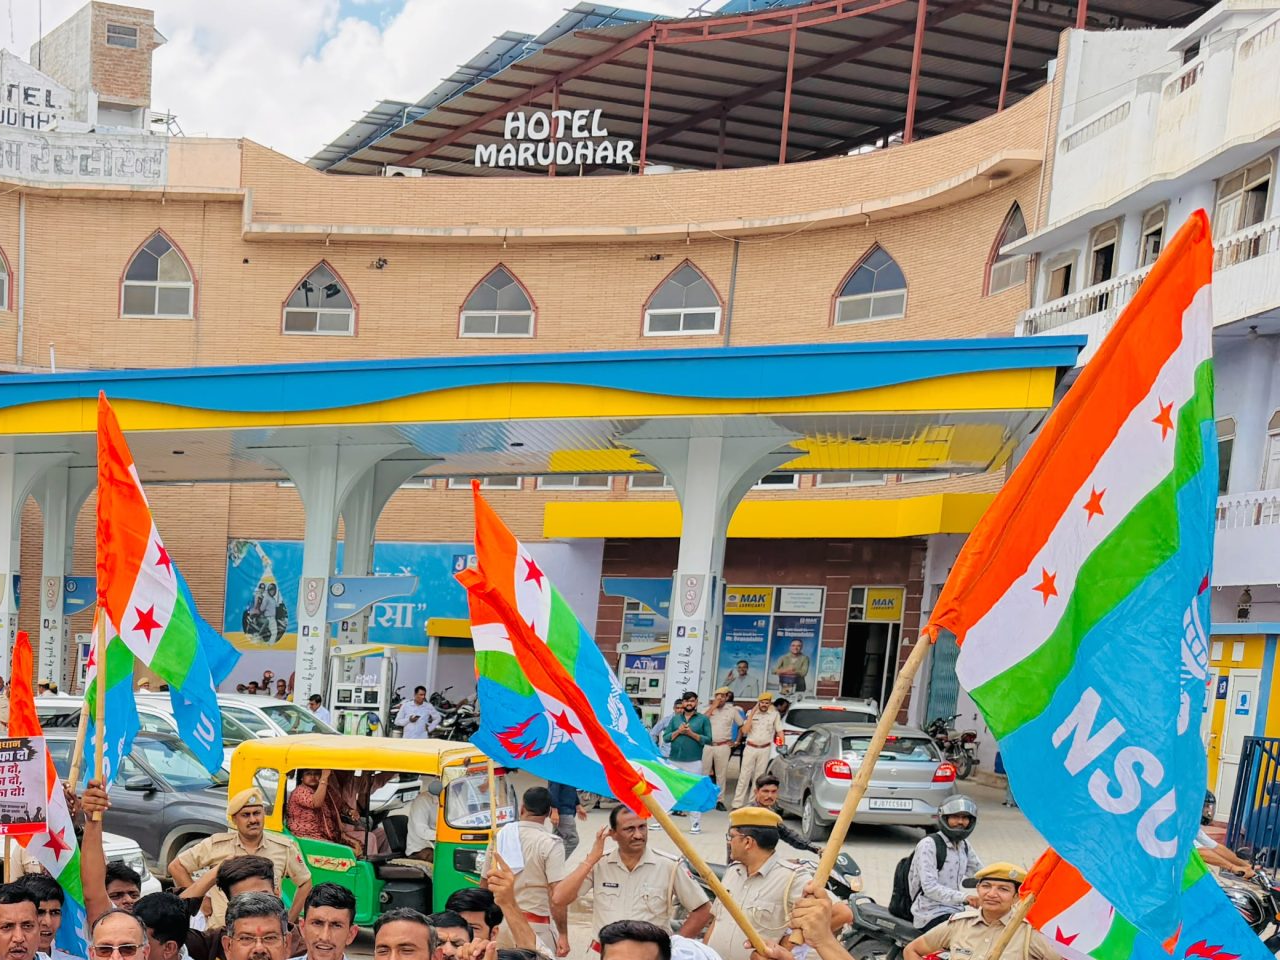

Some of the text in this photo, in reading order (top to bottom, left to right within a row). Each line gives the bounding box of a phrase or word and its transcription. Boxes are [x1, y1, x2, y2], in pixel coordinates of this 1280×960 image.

[504, 109, 608, 140] HOTEL
[474, 141, 634, 167] MARUDHAR
[740, 594, 766, 603] MAK
[871, 598, 895, 607] MAK
[632, 660, 659, 670] ATM
[16, 749, 29, 762] दो
[1052, 687, 1178, 859] NSU
[10, 786, 25, 797] दो!
